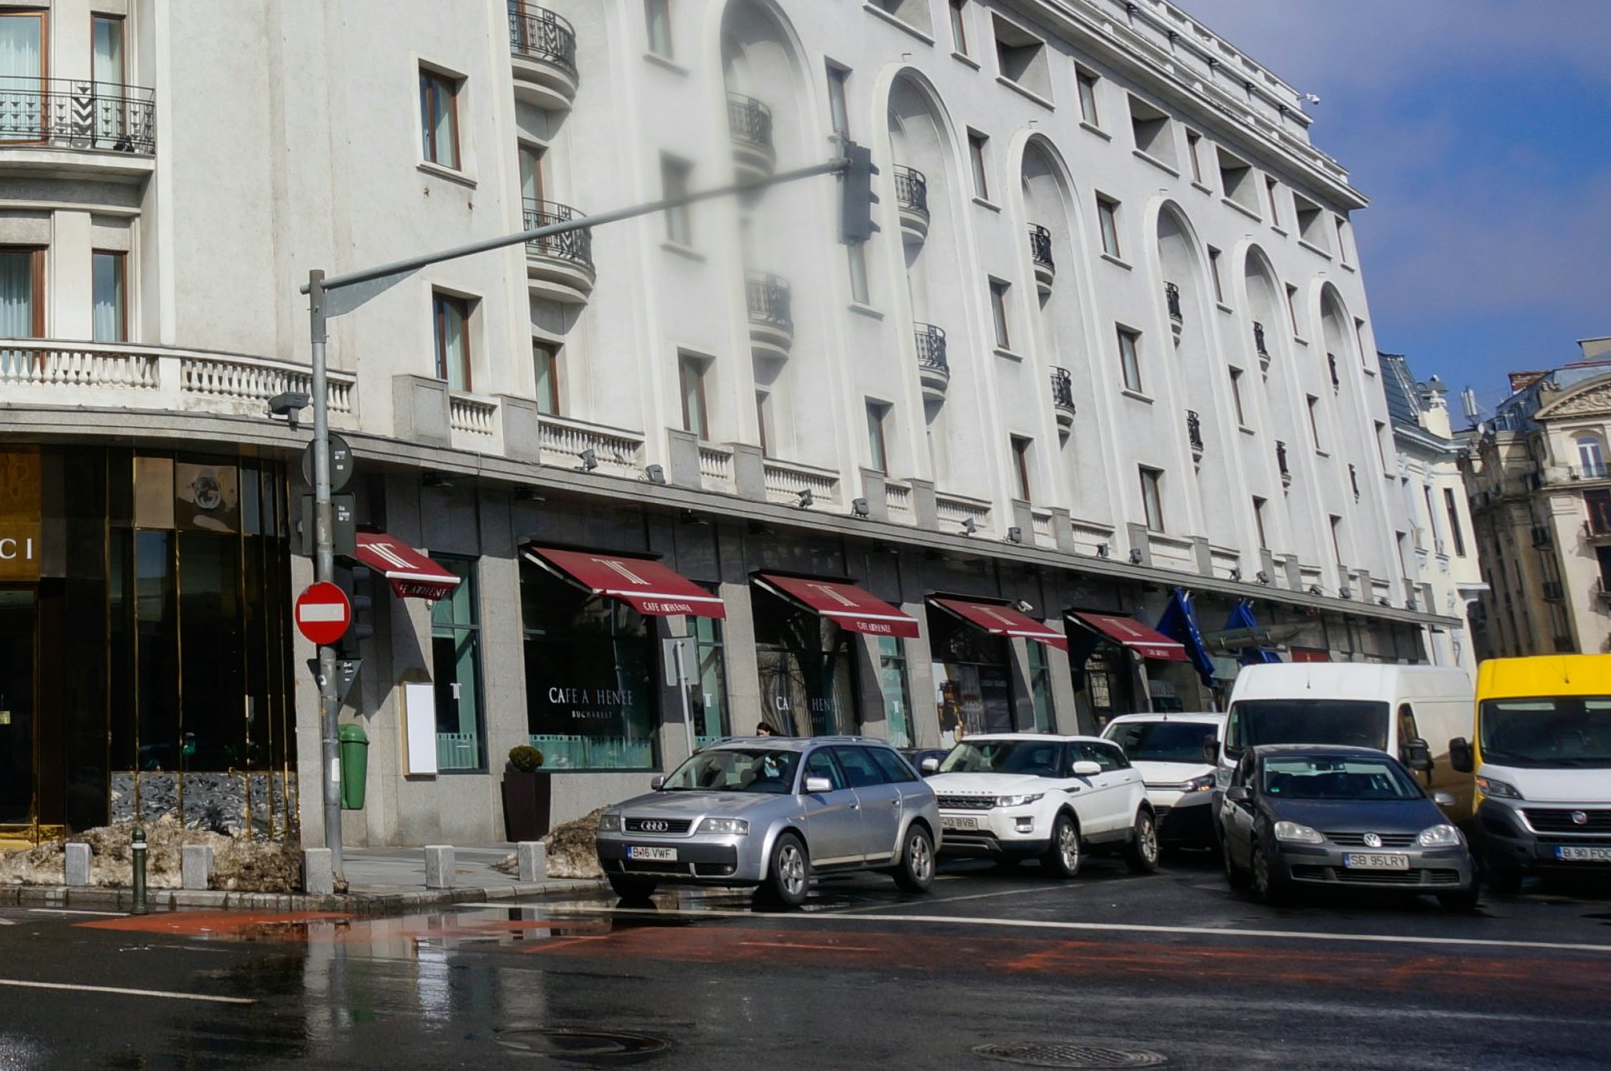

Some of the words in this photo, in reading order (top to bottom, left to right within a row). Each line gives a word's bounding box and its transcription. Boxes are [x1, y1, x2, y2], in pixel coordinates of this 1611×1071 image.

[549, 687, 578, 704] CAFE
[651, 848, 672, 859] VWF
[1351, 855, 1368, 866] SB
[1370, 855, 1383, 866] 95
[1384, 856, 1406, 867] LRY
